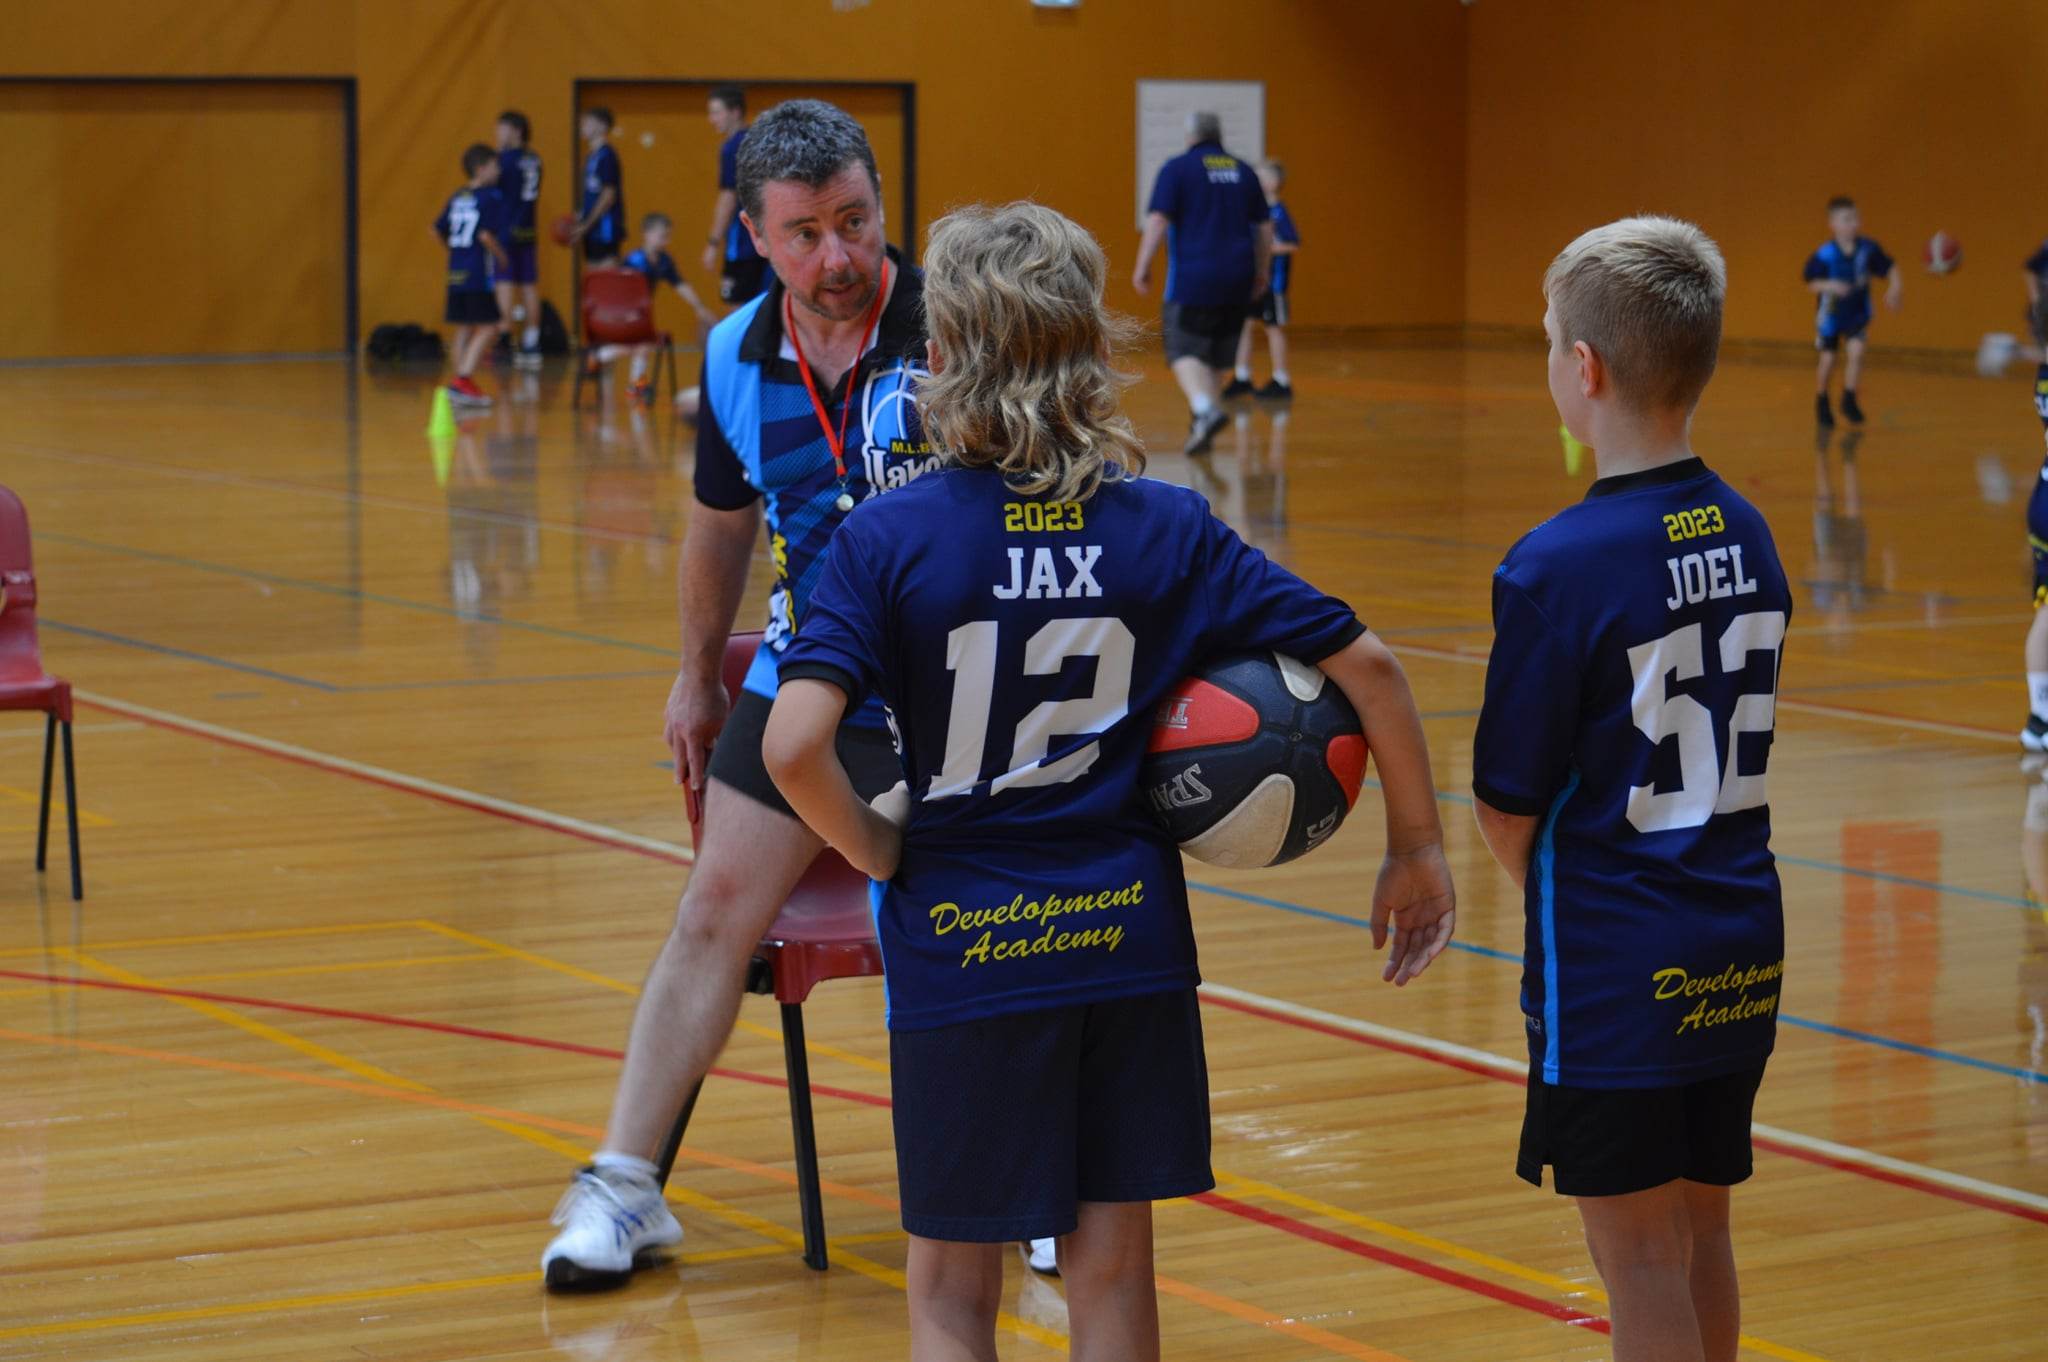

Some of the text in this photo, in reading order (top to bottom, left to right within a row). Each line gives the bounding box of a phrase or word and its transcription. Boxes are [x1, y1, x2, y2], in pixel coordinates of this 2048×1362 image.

[1004, 502, 1084, 532] 2023
[1663, 504, 1726, 542] 2023
[993, 545, 1103, 600] JAX
[1666, 544, 1757, 611] JOEL
[922, 617, 1136, 802] 12
[1625, 610, 1786, 834] 52
[929, 880, 1144, 927] Development
[961, 925, 1125, 968] Academy
